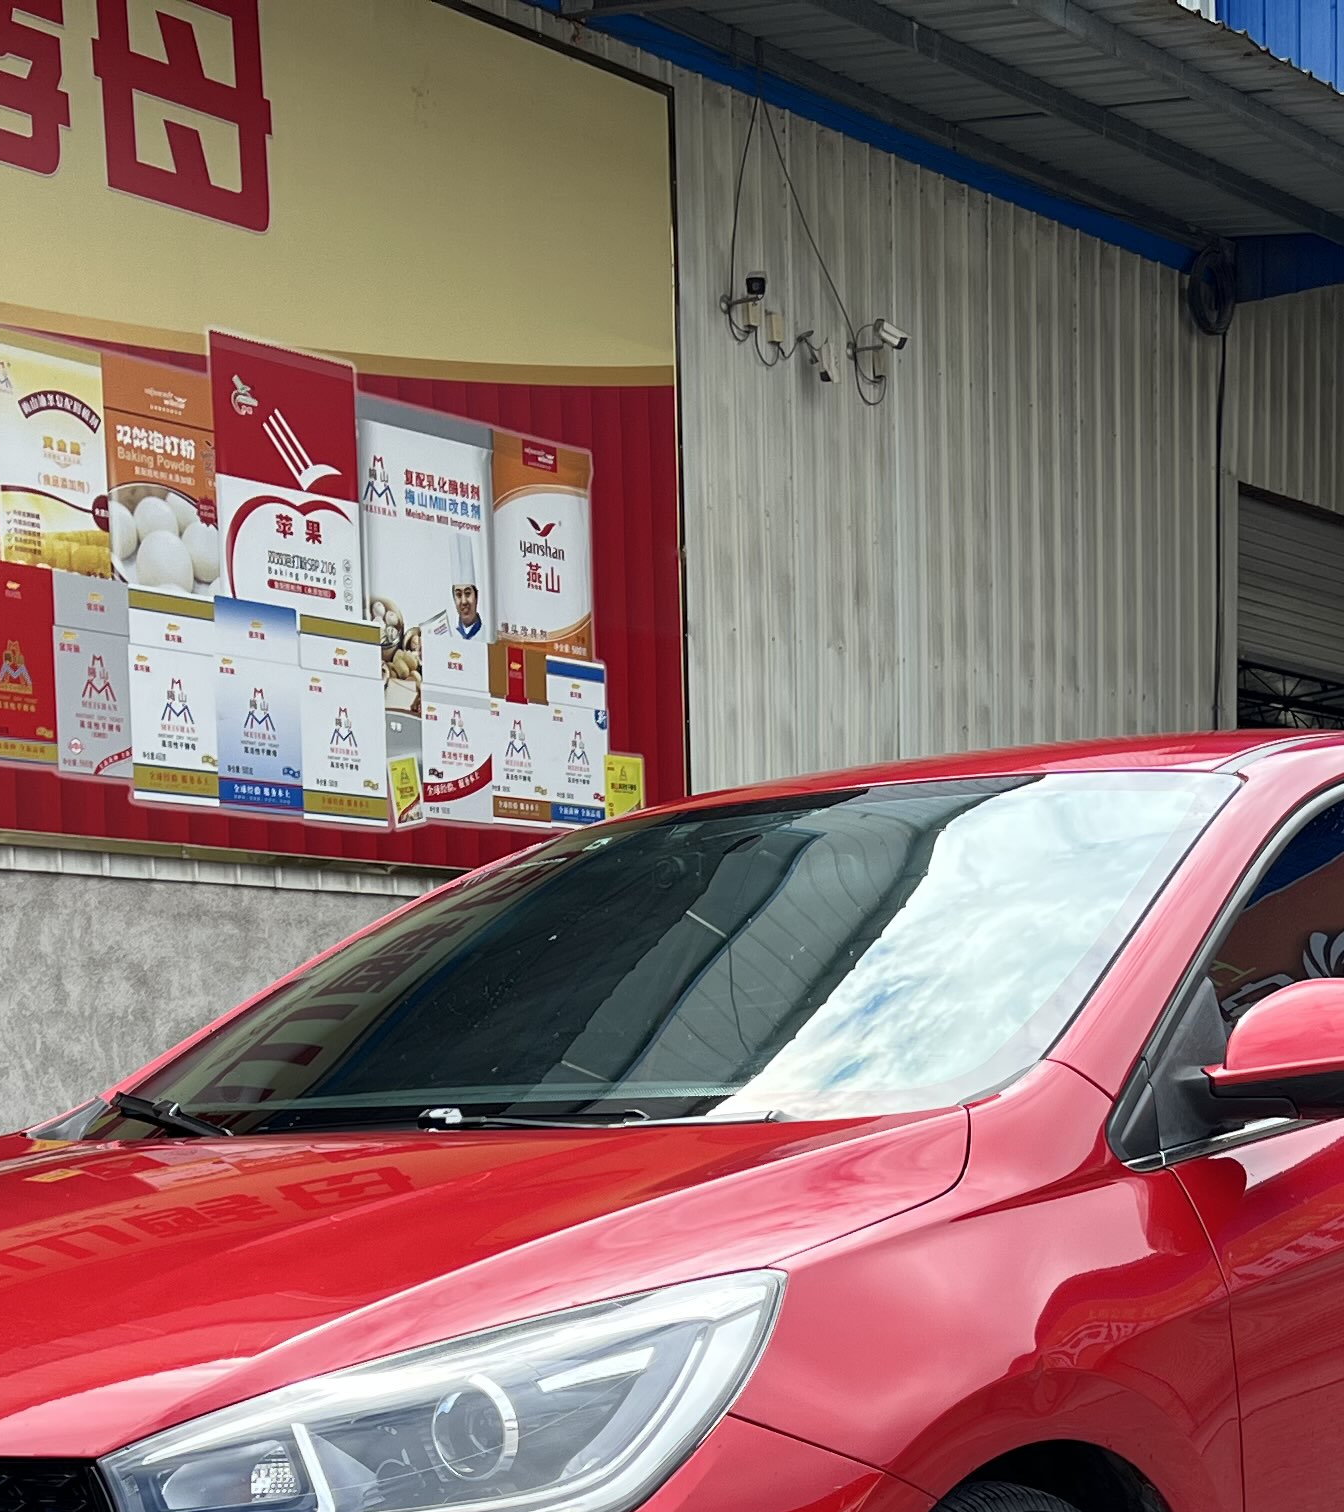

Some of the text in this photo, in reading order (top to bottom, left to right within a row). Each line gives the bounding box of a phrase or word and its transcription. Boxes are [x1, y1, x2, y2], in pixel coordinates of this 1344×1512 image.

[117, 446, 154, 468] Baking
[156, 455, 196, 474] Powder
[275, 513, 322, 545] 苹果
[405, 508, 435, 522] Meishan
[450, 518, 481, 533] Improver
[519, 538, 566, 561] yanshan
[267, 567, 299, 581] Baking
[526, 561, 561, 594] 燕山
